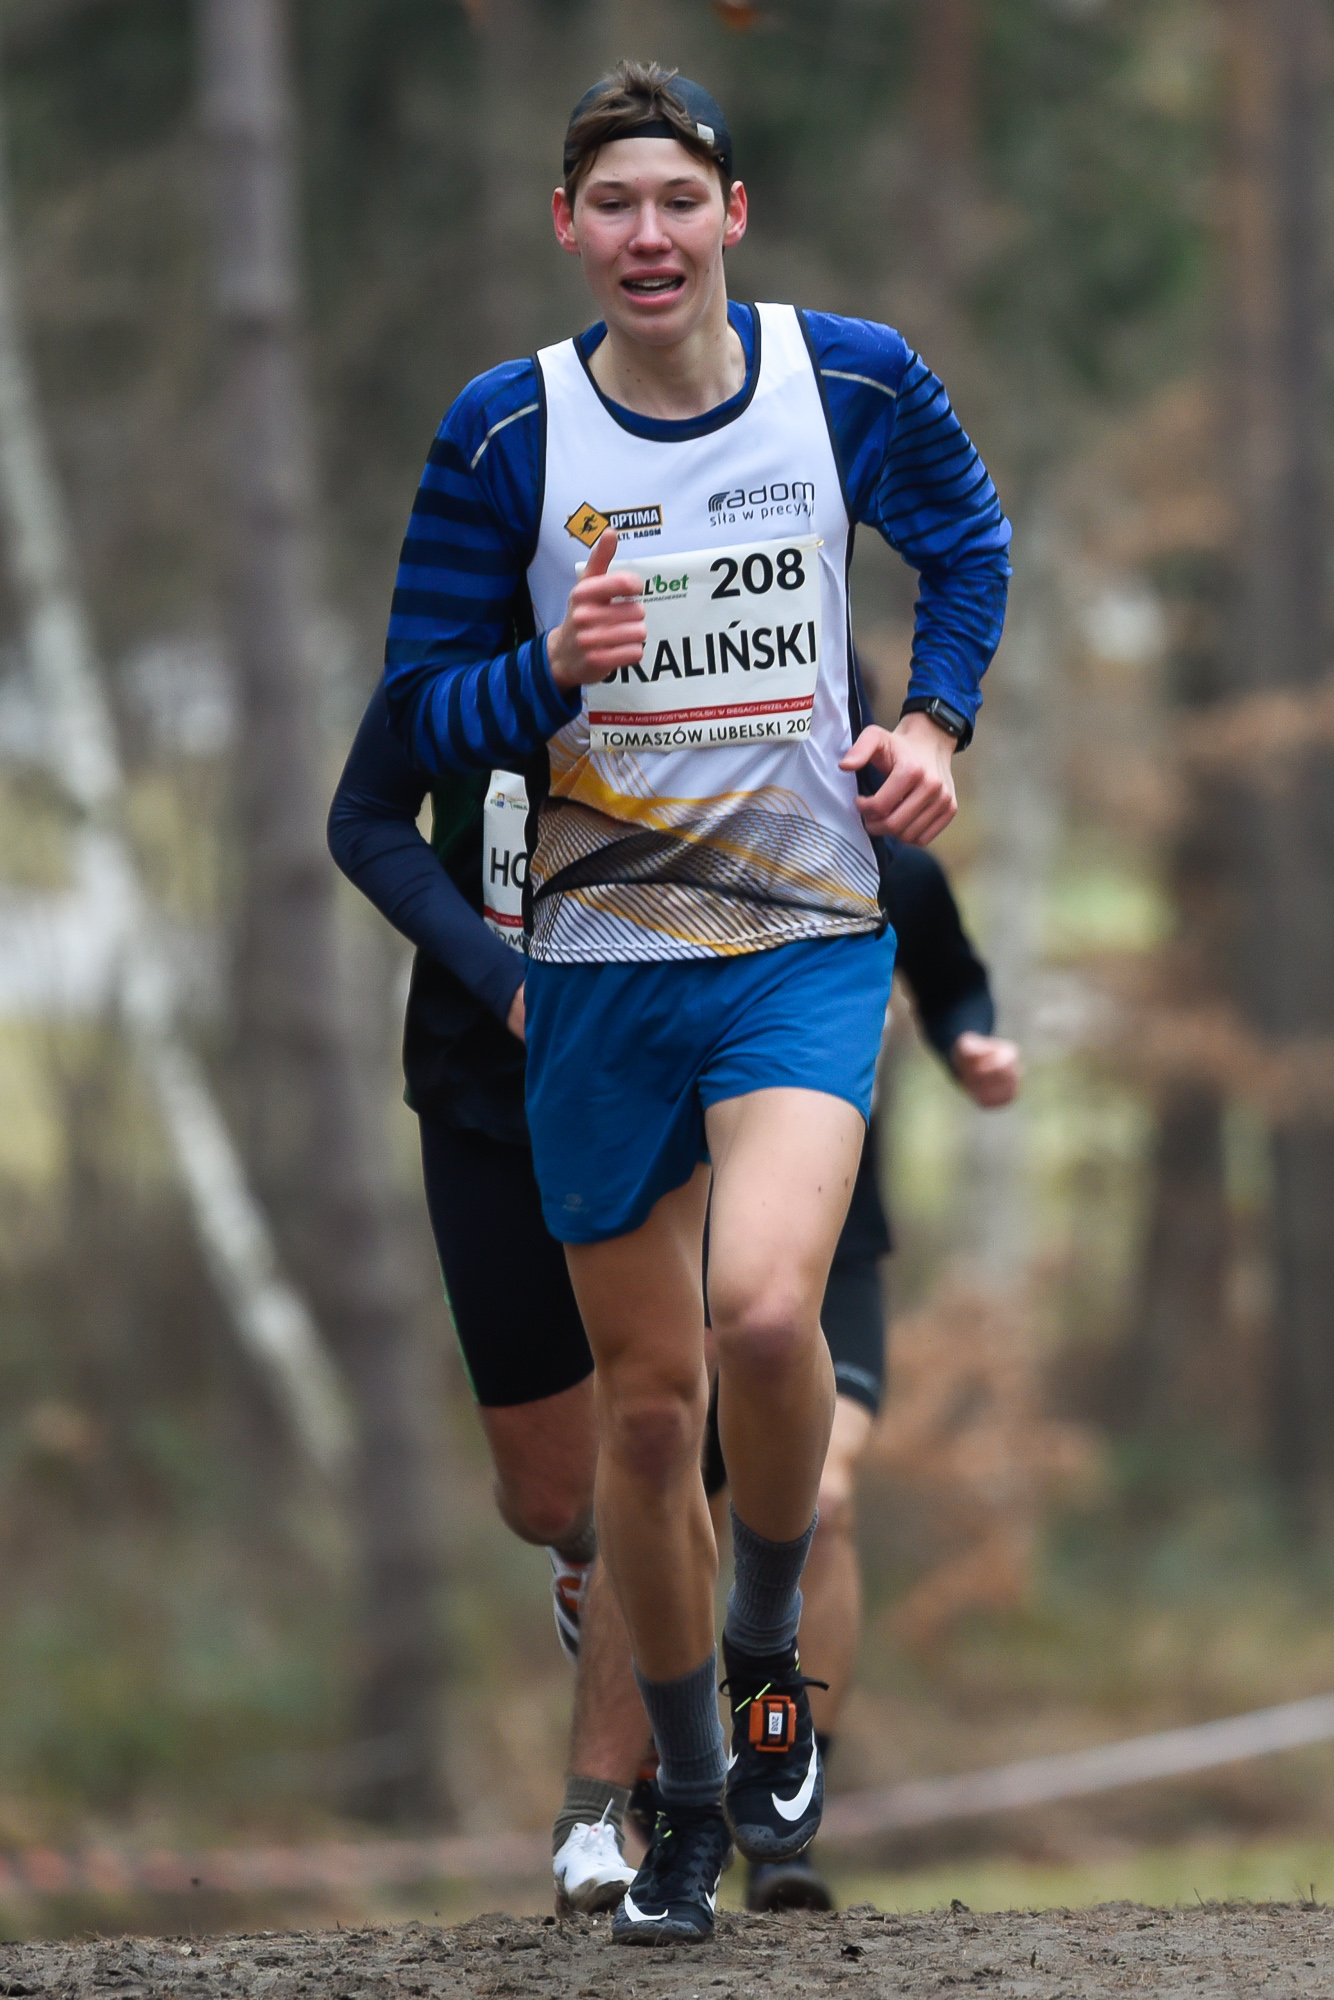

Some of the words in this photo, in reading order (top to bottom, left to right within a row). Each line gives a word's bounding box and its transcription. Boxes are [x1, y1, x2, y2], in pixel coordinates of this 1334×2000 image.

[609, 509, 660, 529] OPTIMA
[743, 510, 754, 521] w
[633, 527, 661, 539] RADOM
[640, 573, 689, 596] Lbet
[709, 548, 805, 600] 208
[600, 620, 817, 684] KALIŃSKI
[718, 705, 725, 715] W
[602, 726, 703, 746] TOMASZÓW
[709, 722, 781, 741] LUBELSKI
